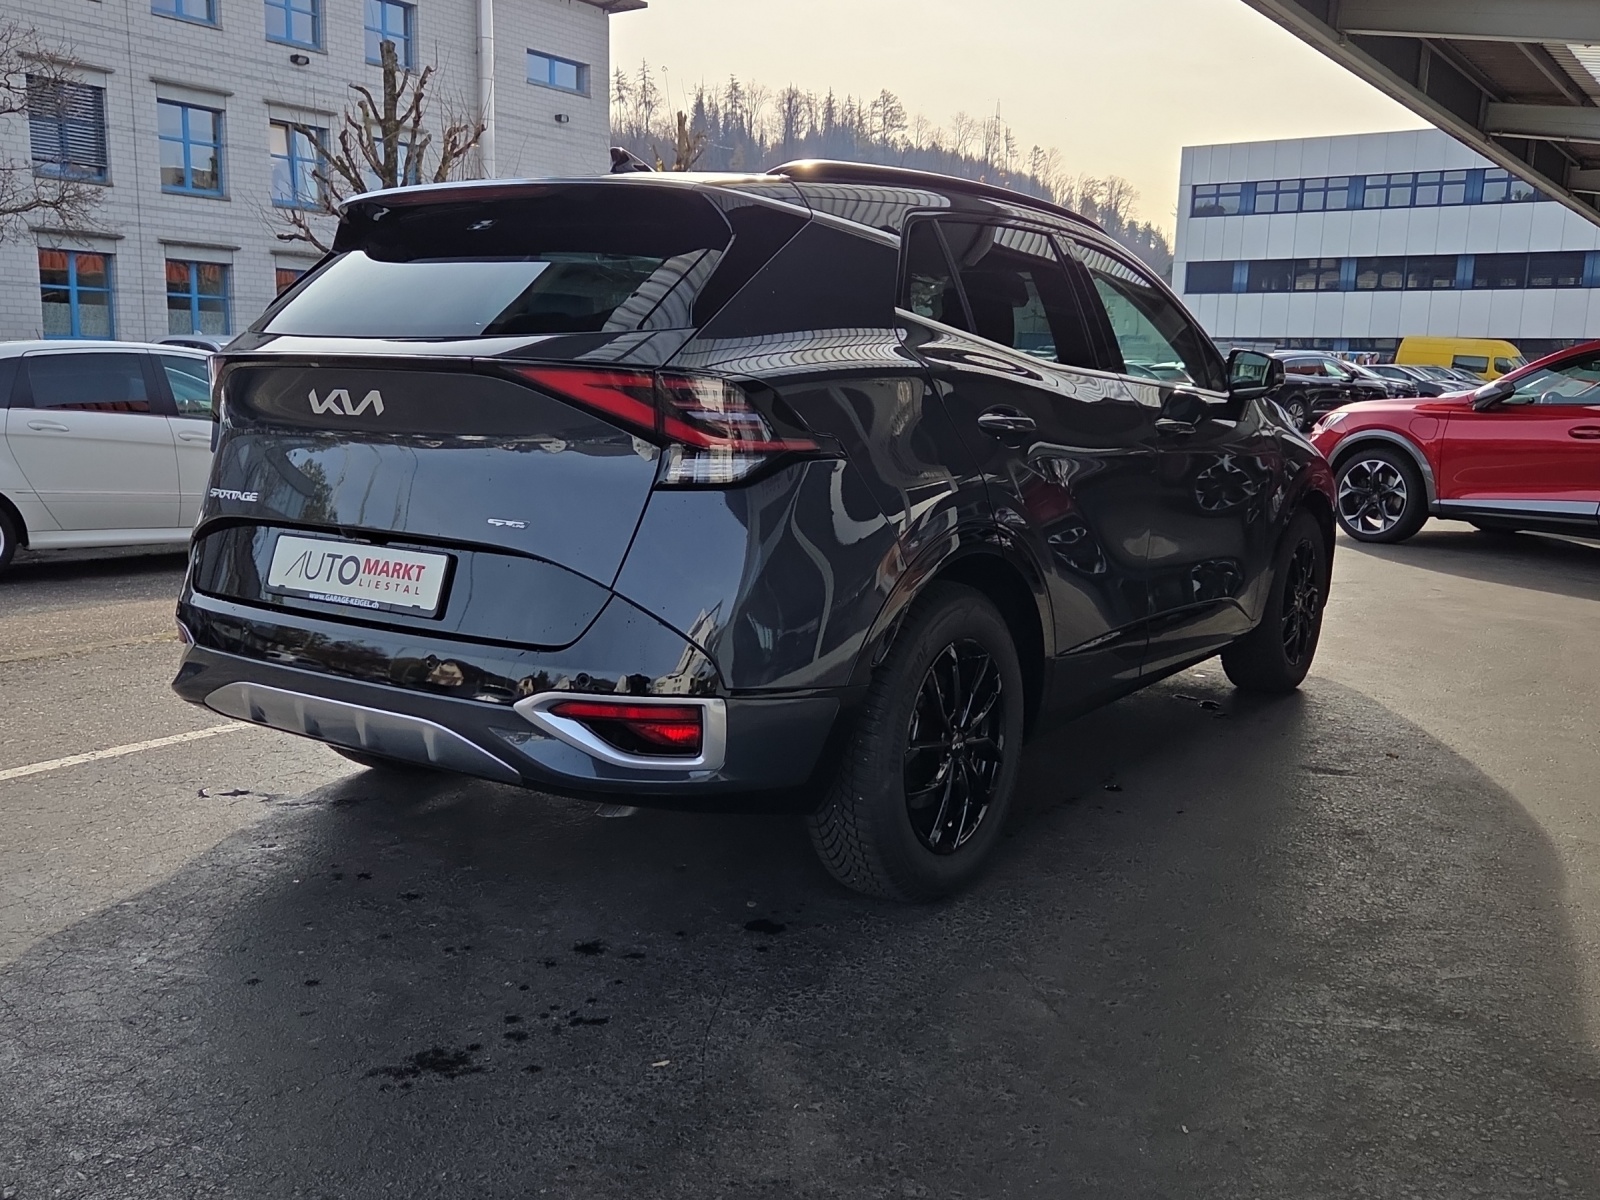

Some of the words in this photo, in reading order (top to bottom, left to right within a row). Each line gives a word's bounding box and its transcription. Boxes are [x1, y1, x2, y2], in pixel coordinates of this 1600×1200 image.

[308, 388, 385, 416] KIA
[210, 487, 259, 502] SPORTAGE
[285, 550, 361, 586] AUTO
[362, 558, 426, 582] MARKT
[358, 578, 421, 596] LIESTAL
